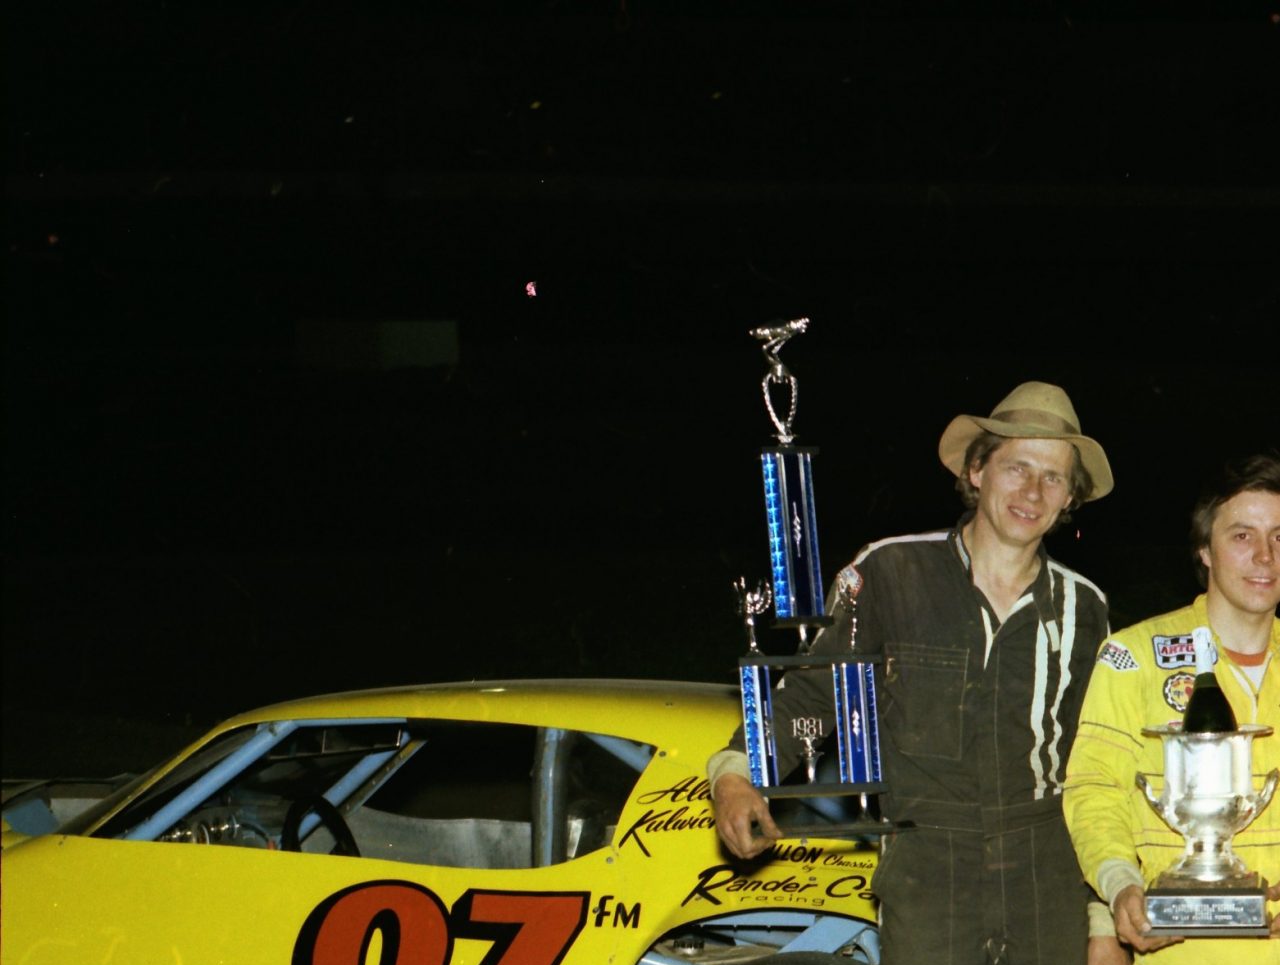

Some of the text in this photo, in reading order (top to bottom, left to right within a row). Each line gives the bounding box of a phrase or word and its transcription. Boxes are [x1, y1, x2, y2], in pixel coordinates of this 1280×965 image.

[792, 717, 822, 737] 1981
[740, 893, 825, 907] racing
[593, 895, 641, 928] FM
